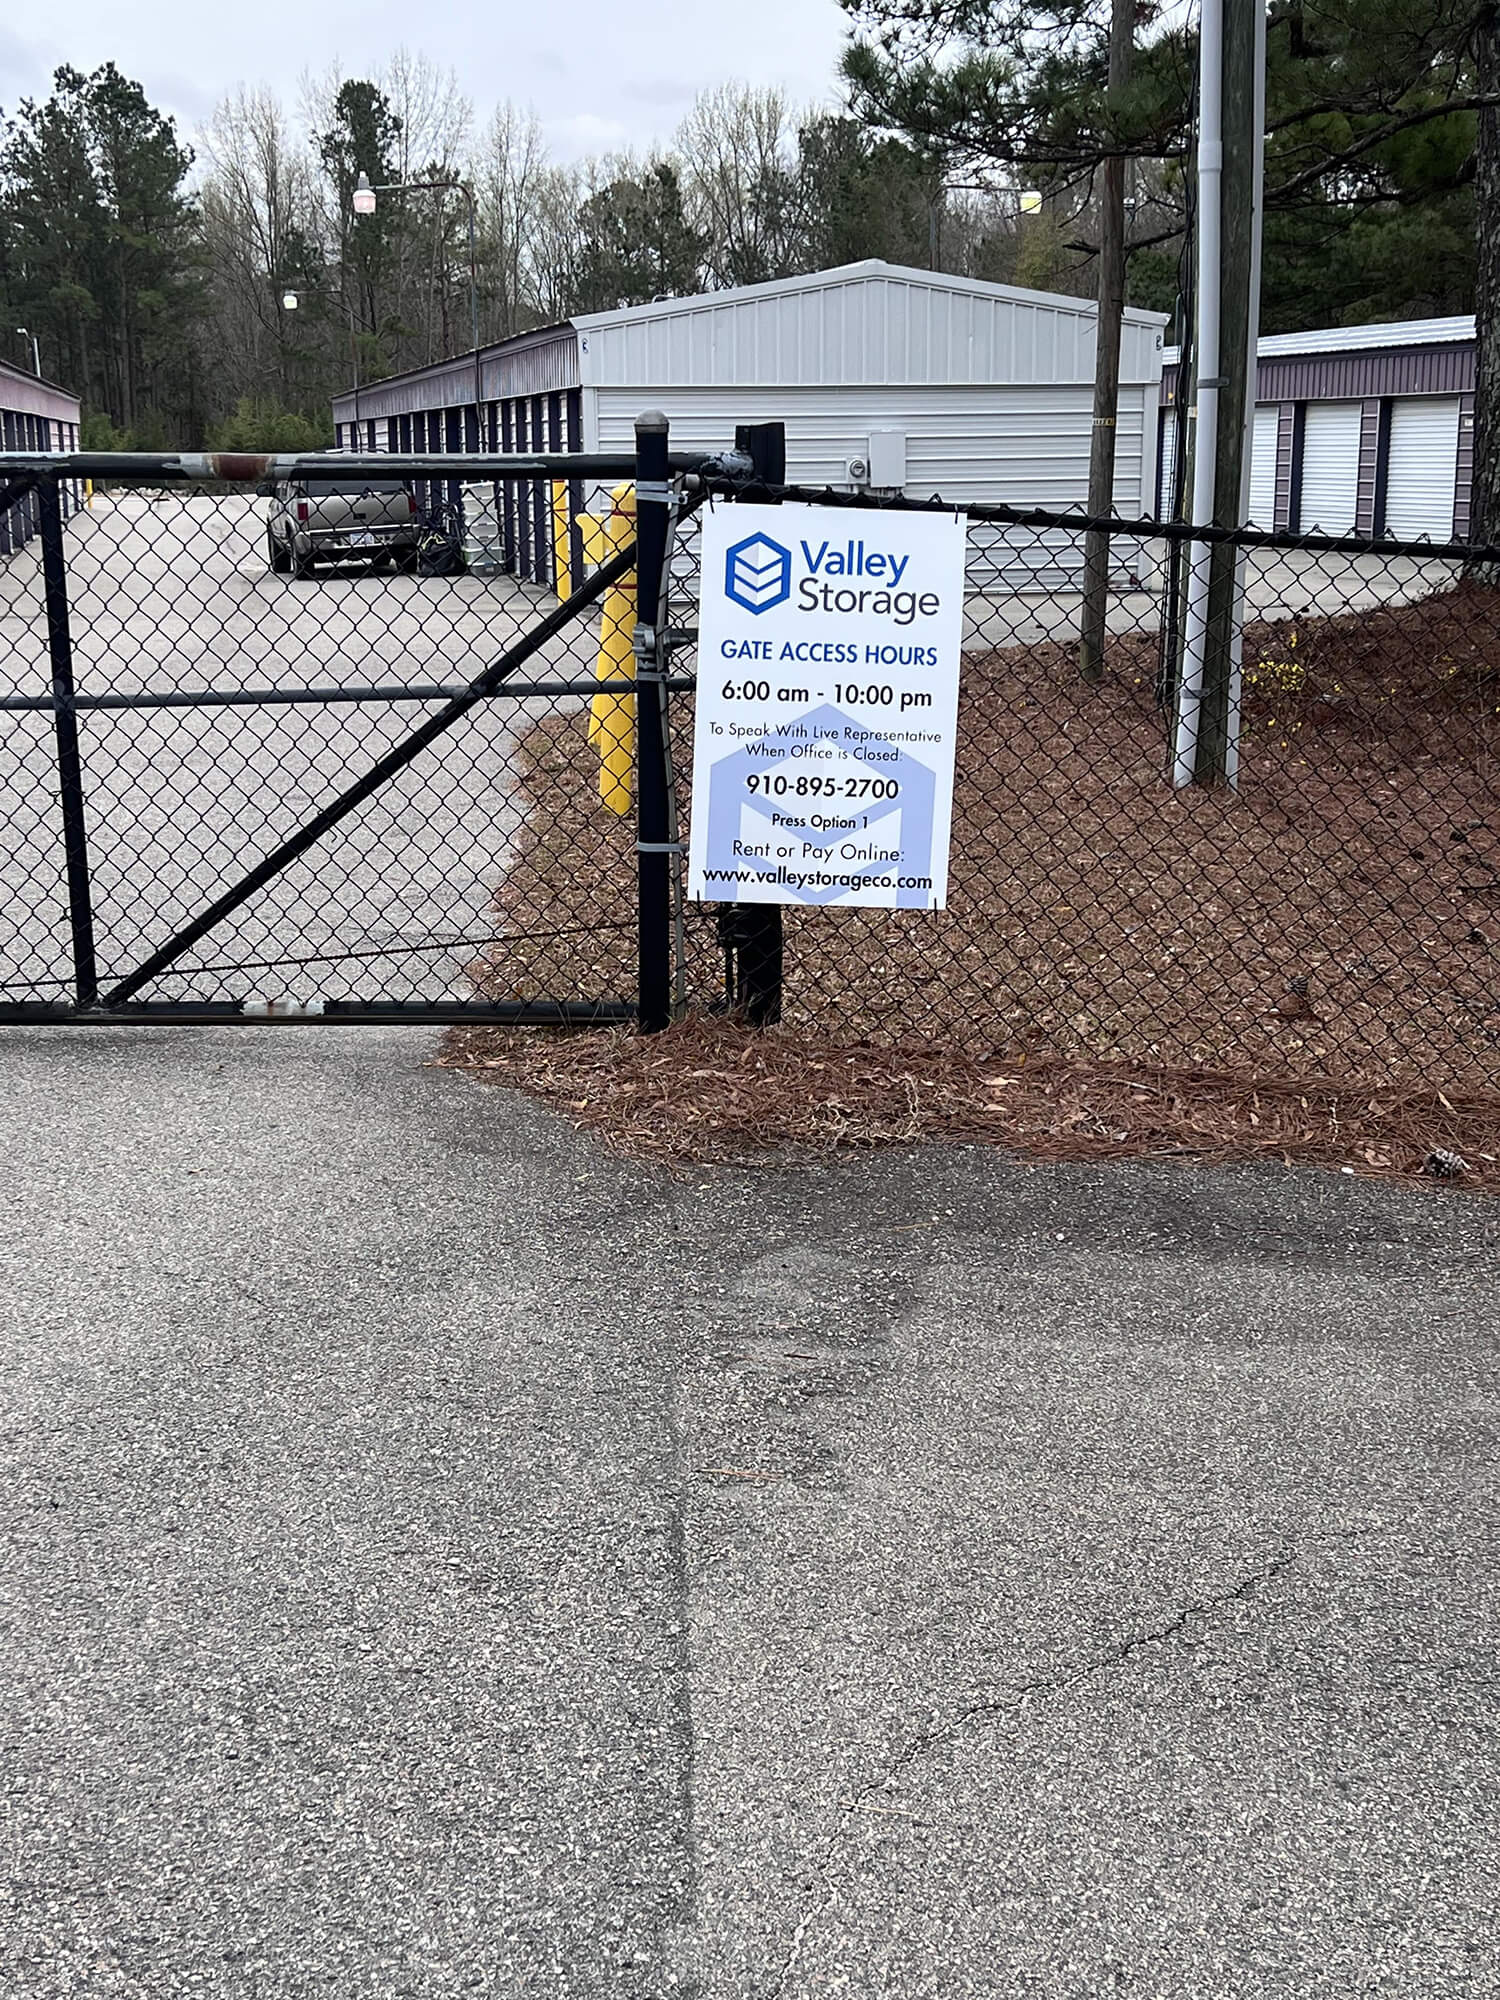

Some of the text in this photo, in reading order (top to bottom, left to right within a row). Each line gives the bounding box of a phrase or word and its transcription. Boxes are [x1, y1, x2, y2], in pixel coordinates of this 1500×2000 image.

[799, 539, 910, 589] Valley
[797, 576, 940, 626] Storage
[720, 639, 938, 667] GATE ACCESS HOURS
[721, 679, 770, 702] 6:00
[776, 688, 809, 703] am
[834, 684, 894, 706] 10:00
[900, 692, 932, 713] pm
[709, 721, 942, 743] To Speak With Live Representative
[745, 743, 903, 762] When Office is Closed:
[746, 774, 899, 800] 910-895-2700
[772, 812, 868, 832] Press Option 1
[732, 839, 905, 863] Rent or Pay Online:
[702, 866, 933, 891] www.valleystorageco.com
